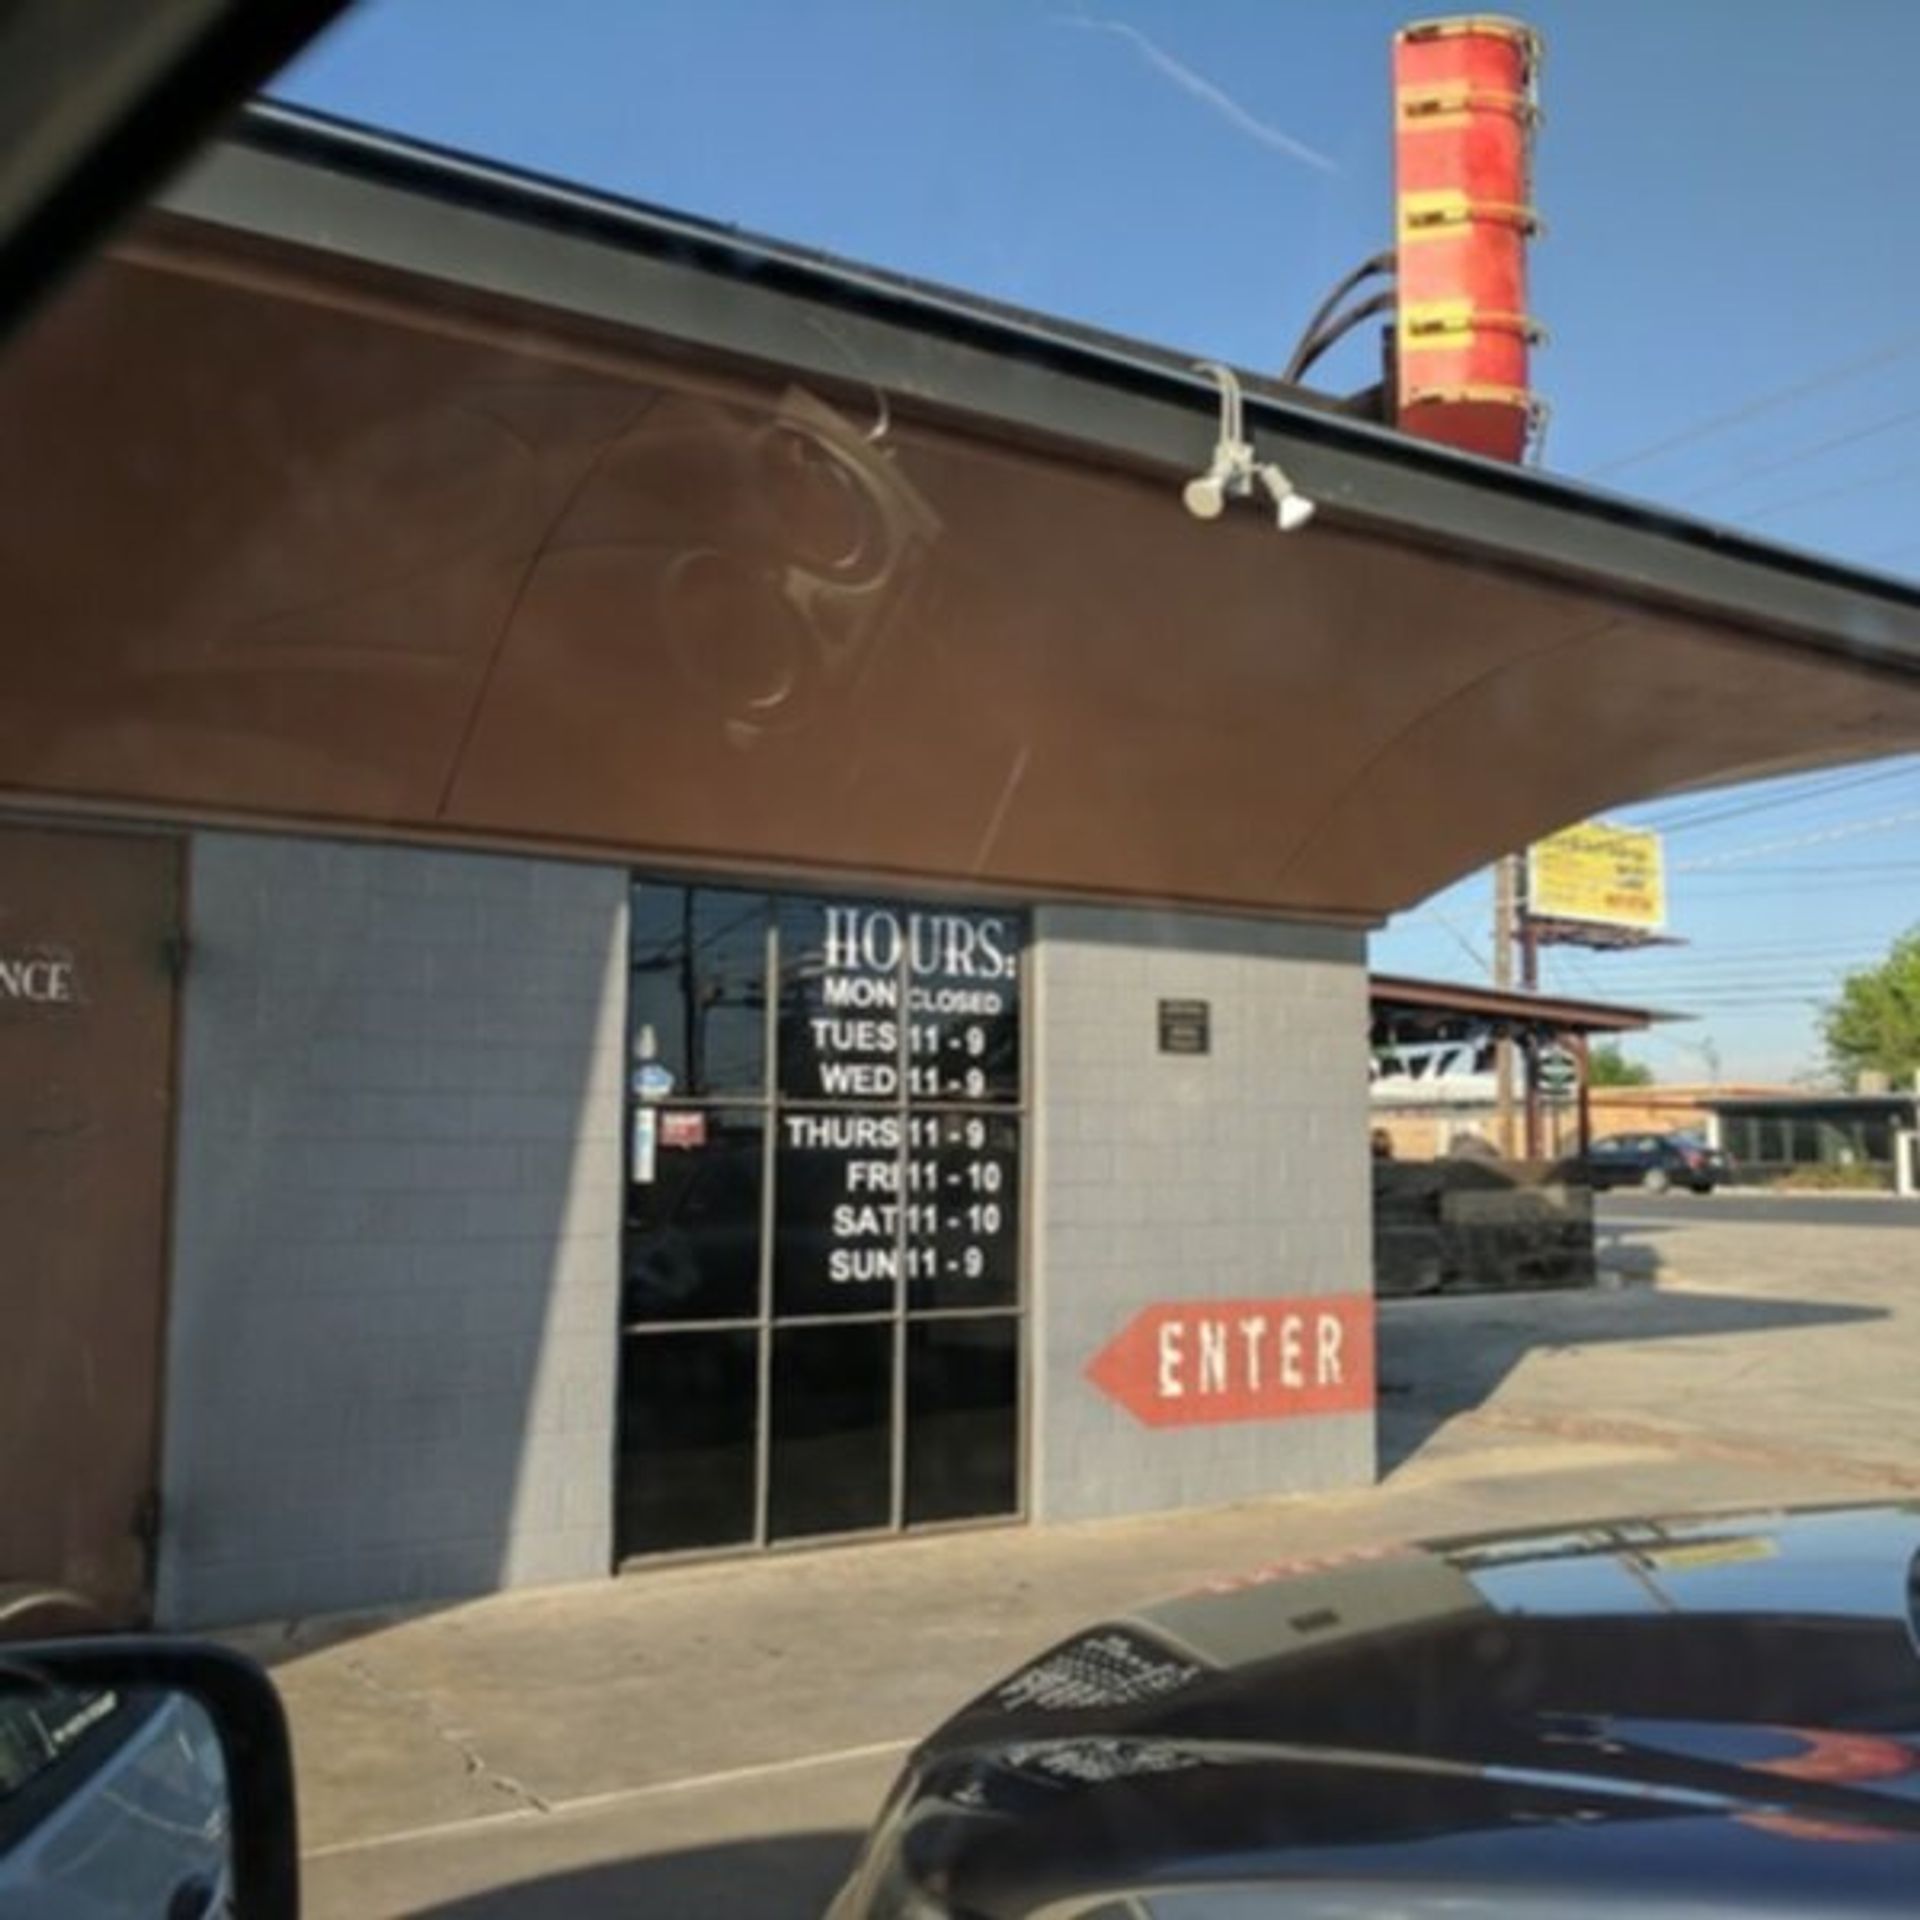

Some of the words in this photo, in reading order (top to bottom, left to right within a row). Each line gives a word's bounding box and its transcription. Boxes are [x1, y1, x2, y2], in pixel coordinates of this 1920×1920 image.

[823, 908, 1017, 978] HOURS:
[822, 976, 897, 1008] MON
[908, 988, 1002, 1014] CLOSED
[810, 1019, 898, 1053] TUES
[909, 1025, 938, 1053] 11
[966, 1027, 985, 1056] 9
[819, 1063, 898, 1095] WED
[908, 1067, 938, 1095] 11
[966, 1068, 985, 1098] 9
[785, 1117, 900, 1149] THURS
[909, 1118, 938, 1147] 11
[966, 1119, 985, 1149] 9
[847, 1161, 901, 1192] FRI
[908, 1161, 937, 1191] 11
[967, 1161, 1001, 1192] 10
[832, 1205, 901, 1237] SAT
[907, 1205, 937, 1234] 11
[968, 1204, 1000, 1234] 10
[828, 1249, 901, 1282] SUN
[905, 1249, 937, 1277] 11
[963, 1247, 983, 1278] 9
[1158, 1313, 1343, 1396] ENTER
